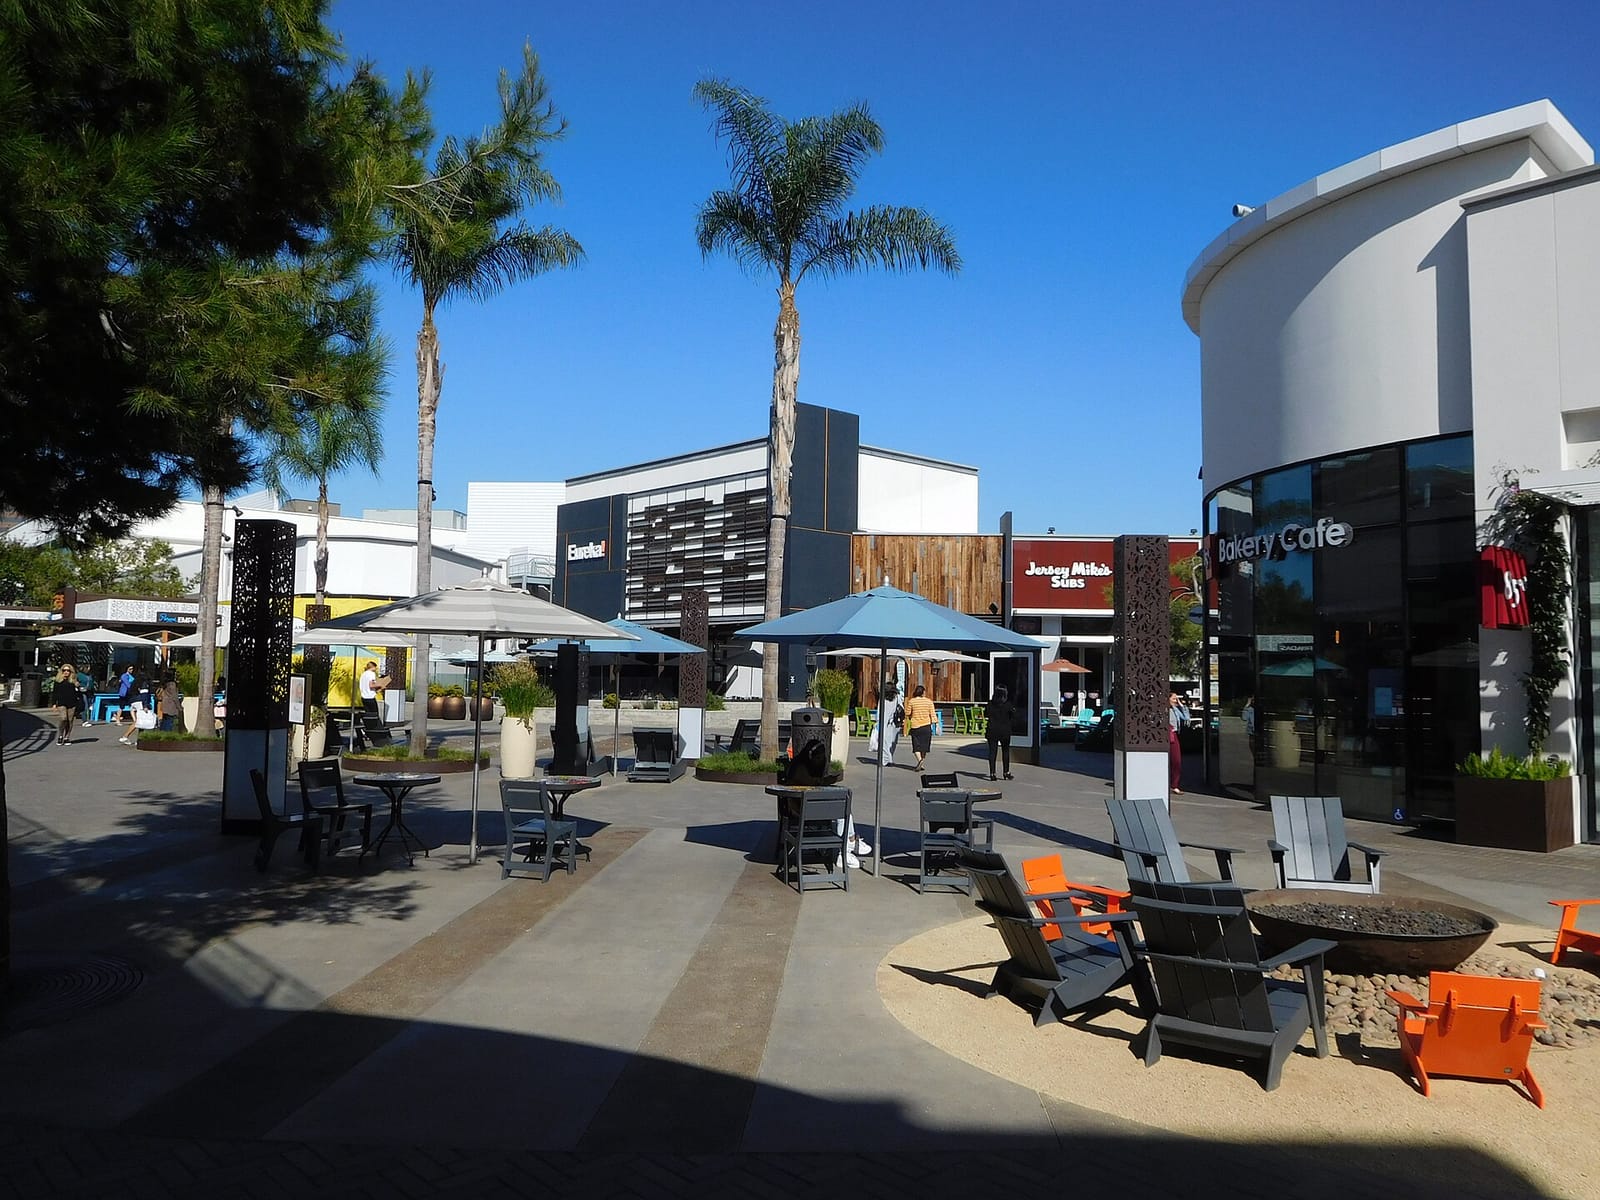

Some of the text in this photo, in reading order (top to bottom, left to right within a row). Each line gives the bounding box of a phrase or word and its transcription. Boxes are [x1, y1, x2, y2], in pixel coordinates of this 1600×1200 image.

[1218, 532, 1276, 562] Bakery
[1280, 517, 1347, 552] Cafe
[568, 541, 606, 561] Eureka!
[1025, 561, 1113, 578] Jersey Mike's
